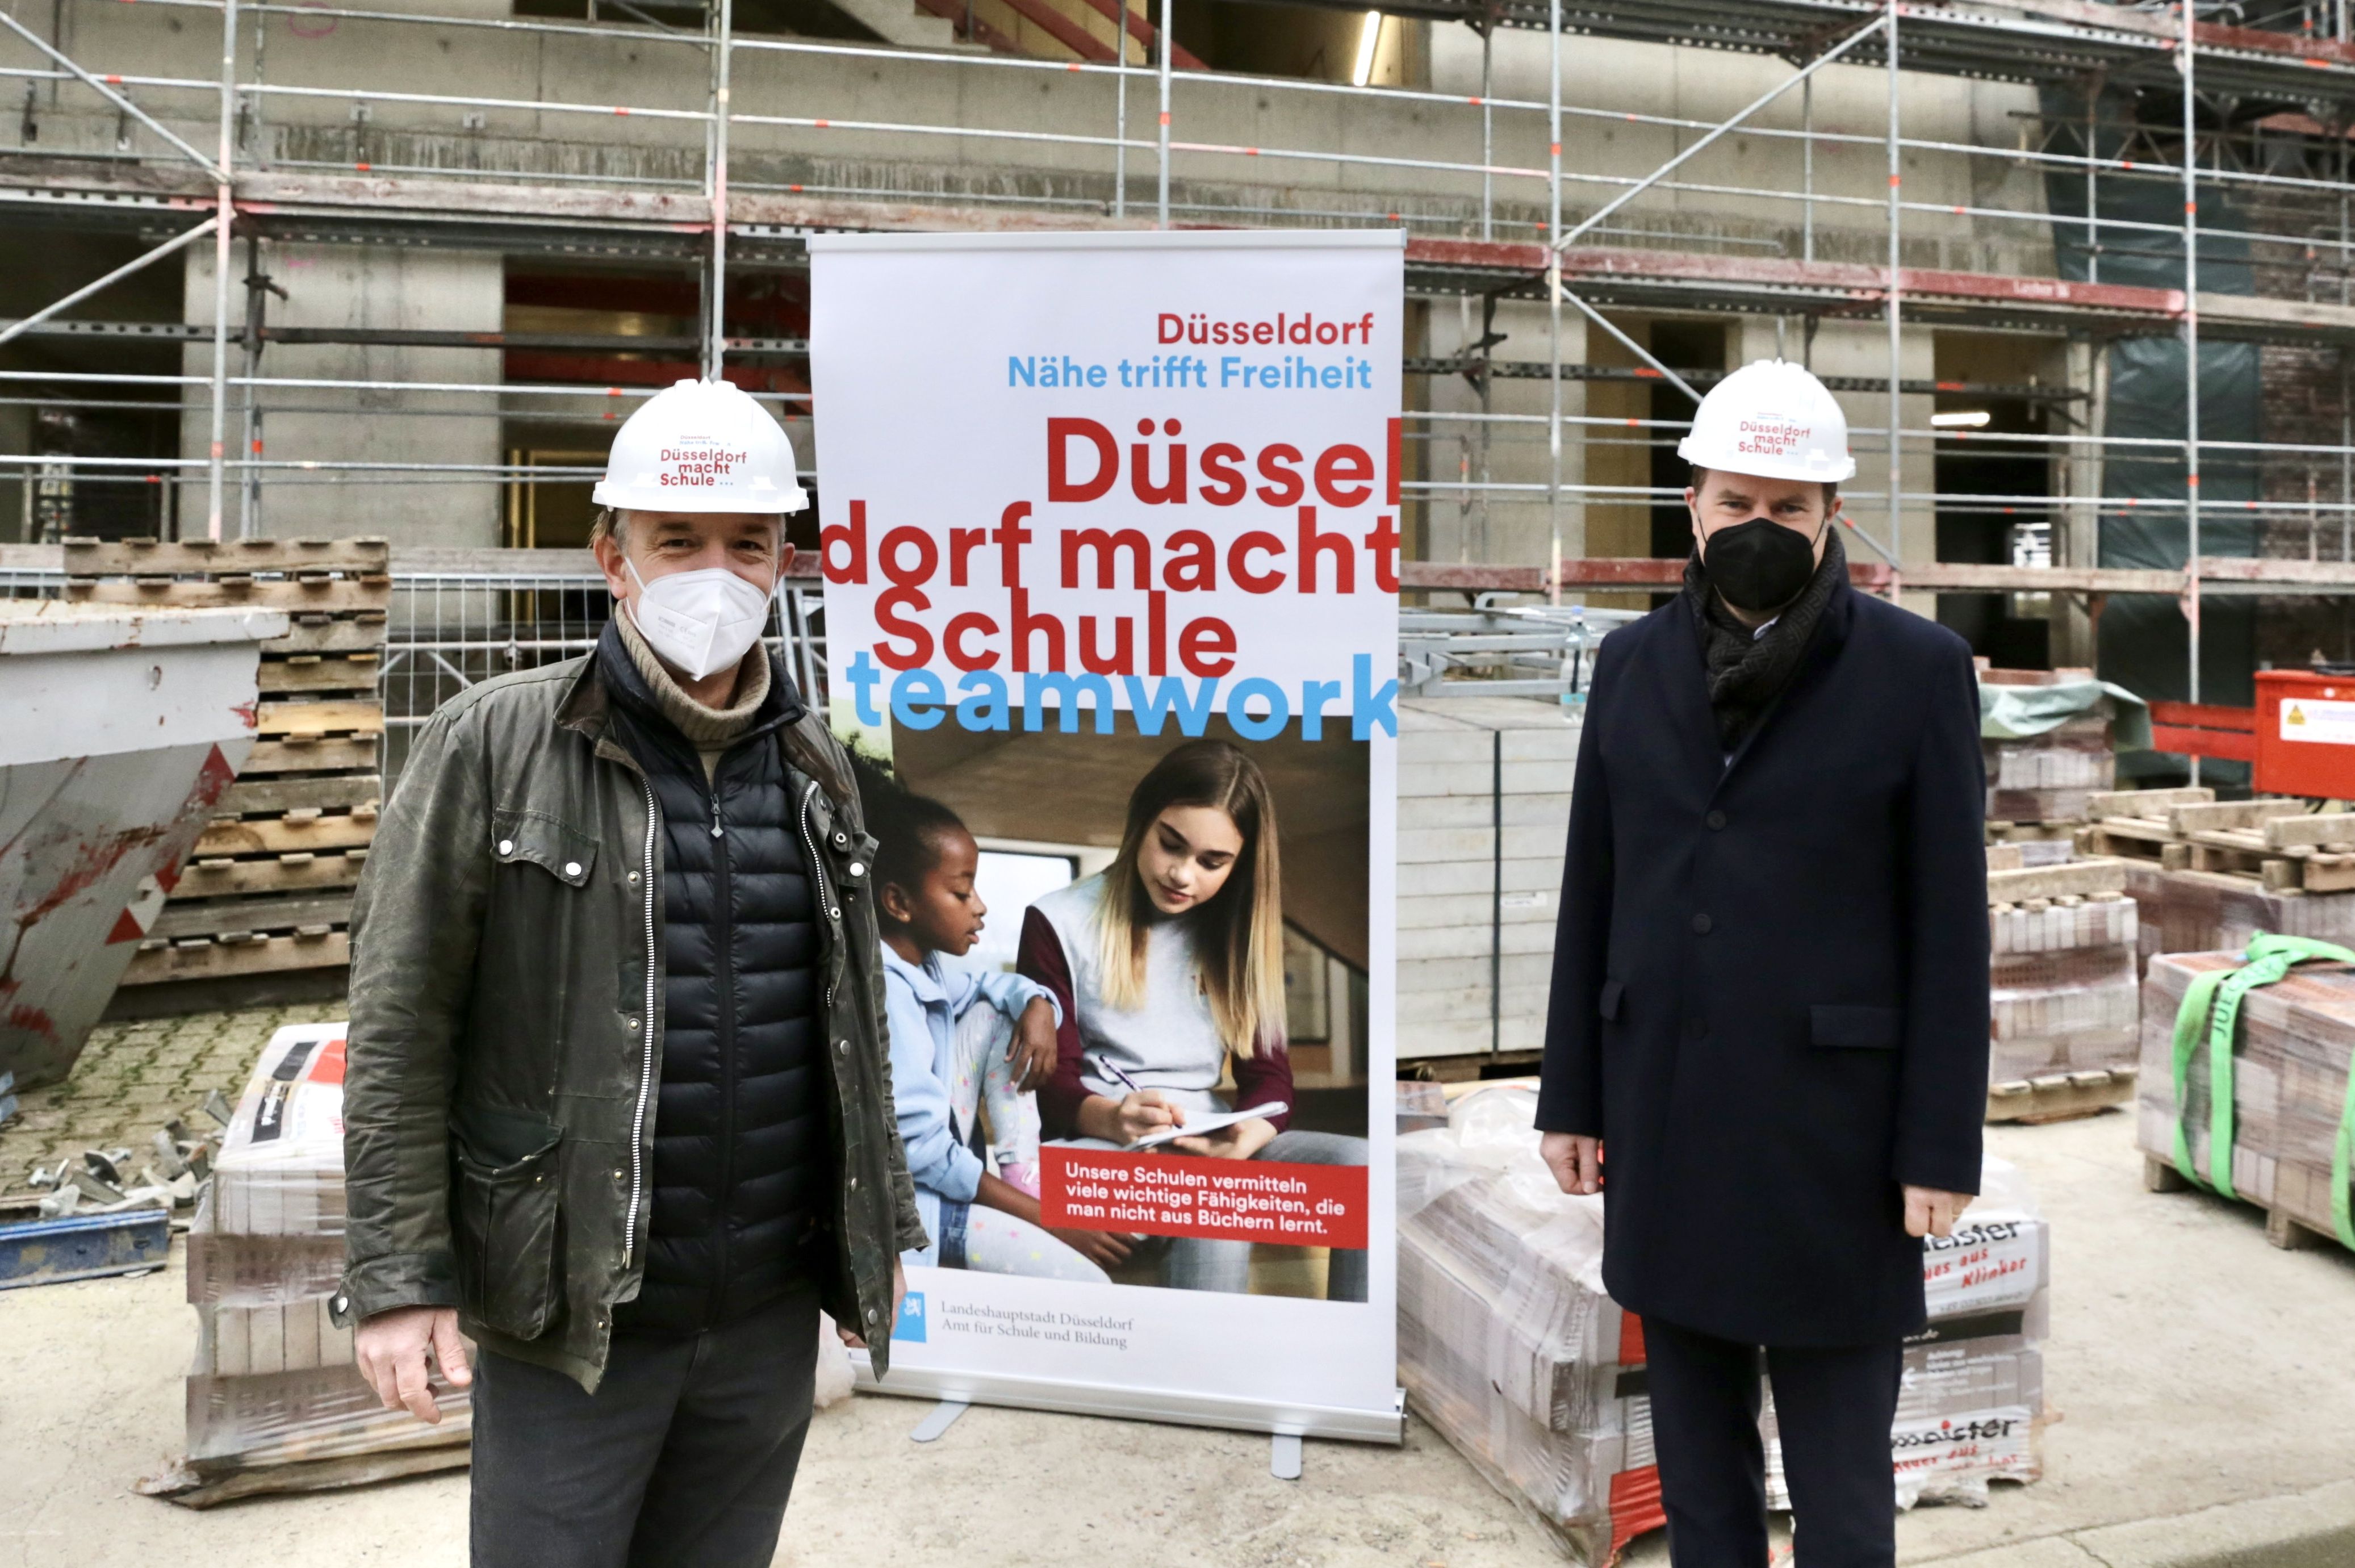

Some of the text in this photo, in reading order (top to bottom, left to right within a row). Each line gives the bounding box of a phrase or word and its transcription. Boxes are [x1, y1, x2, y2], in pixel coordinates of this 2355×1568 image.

[1157, 312, 1374, 345] Düsseldorf
[1008, 355, 1372, 389] Nähe trifft Freiheit
[1739, 421, 1811, 438] Düsseldorf
[1754, 434, 1796, 446] macht
[660, 448, 747, 463] Düsseldorf
[1047, 417, 1402, 508] Düssel
[1738, 441, 1783, 455] Schule
[660, 473, 715, 486] Schule
[678, 461, 730, 474] macht
[821, 500, 1399, 594] dorf macht
[872, 585, 1237, 677] Schule
[846, 651, 1399, 741] teamwork
[1065, 1161, 1307, 1194] Unsere Schulen vermitteln
[1065, 1181, 1346, 1216] viele wichtige Fähigkeiten, die
[1066, 1203, 1328, 1234] man nicht aus Büchern lernt.
[1960, 1248, 1989, 1268] aus
[1961, 1257, 2027, 1290] Klinker
[941, 1300, 1135, 1331] Landeshauptstadt Düsseldorf
[942, 1318, 1128, 1350] Amt für Schule und Bildung
